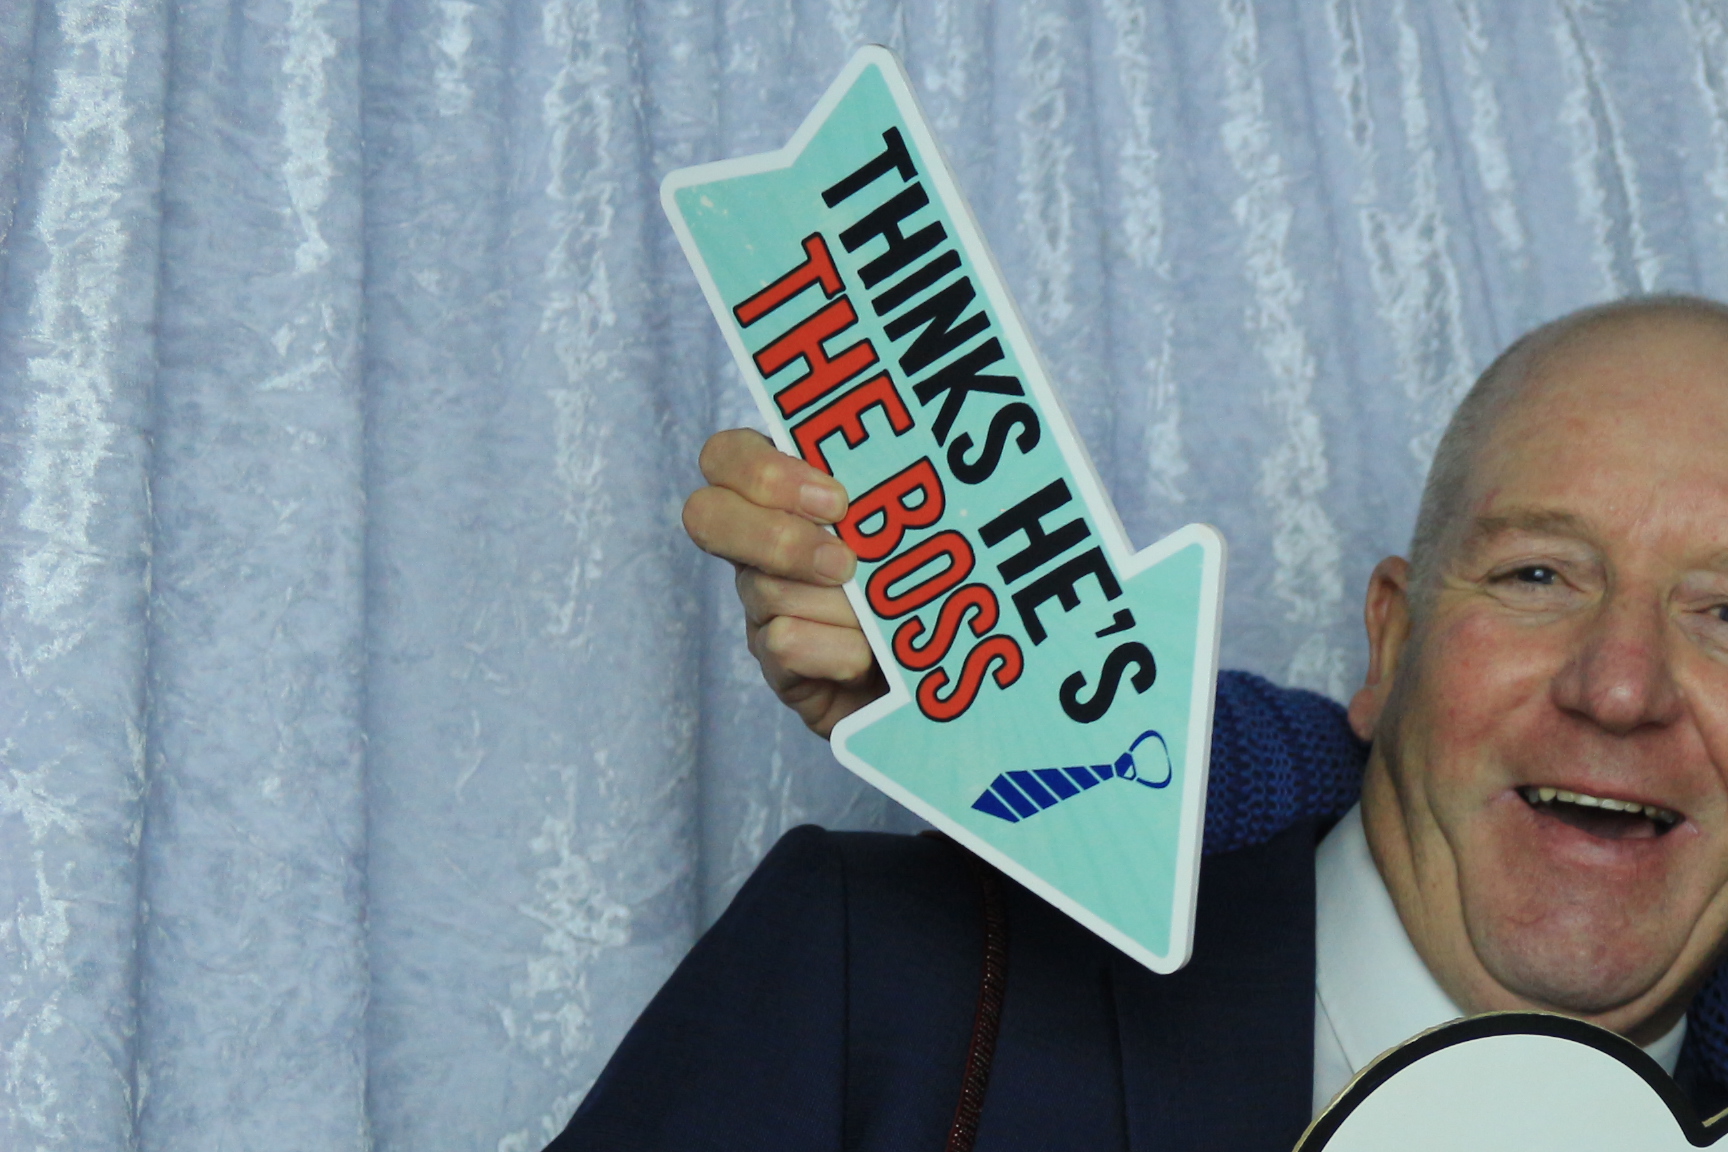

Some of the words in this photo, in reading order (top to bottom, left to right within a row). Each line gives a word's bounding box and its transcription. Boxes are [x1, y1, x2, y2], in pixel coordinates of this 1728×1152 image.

[732, 231, 915, 477] THE
[833, 455, 1024, 723] BOSS
[820, 126, 1041, 485] THINKS
[977, 477, 1157, 724] HE'S
